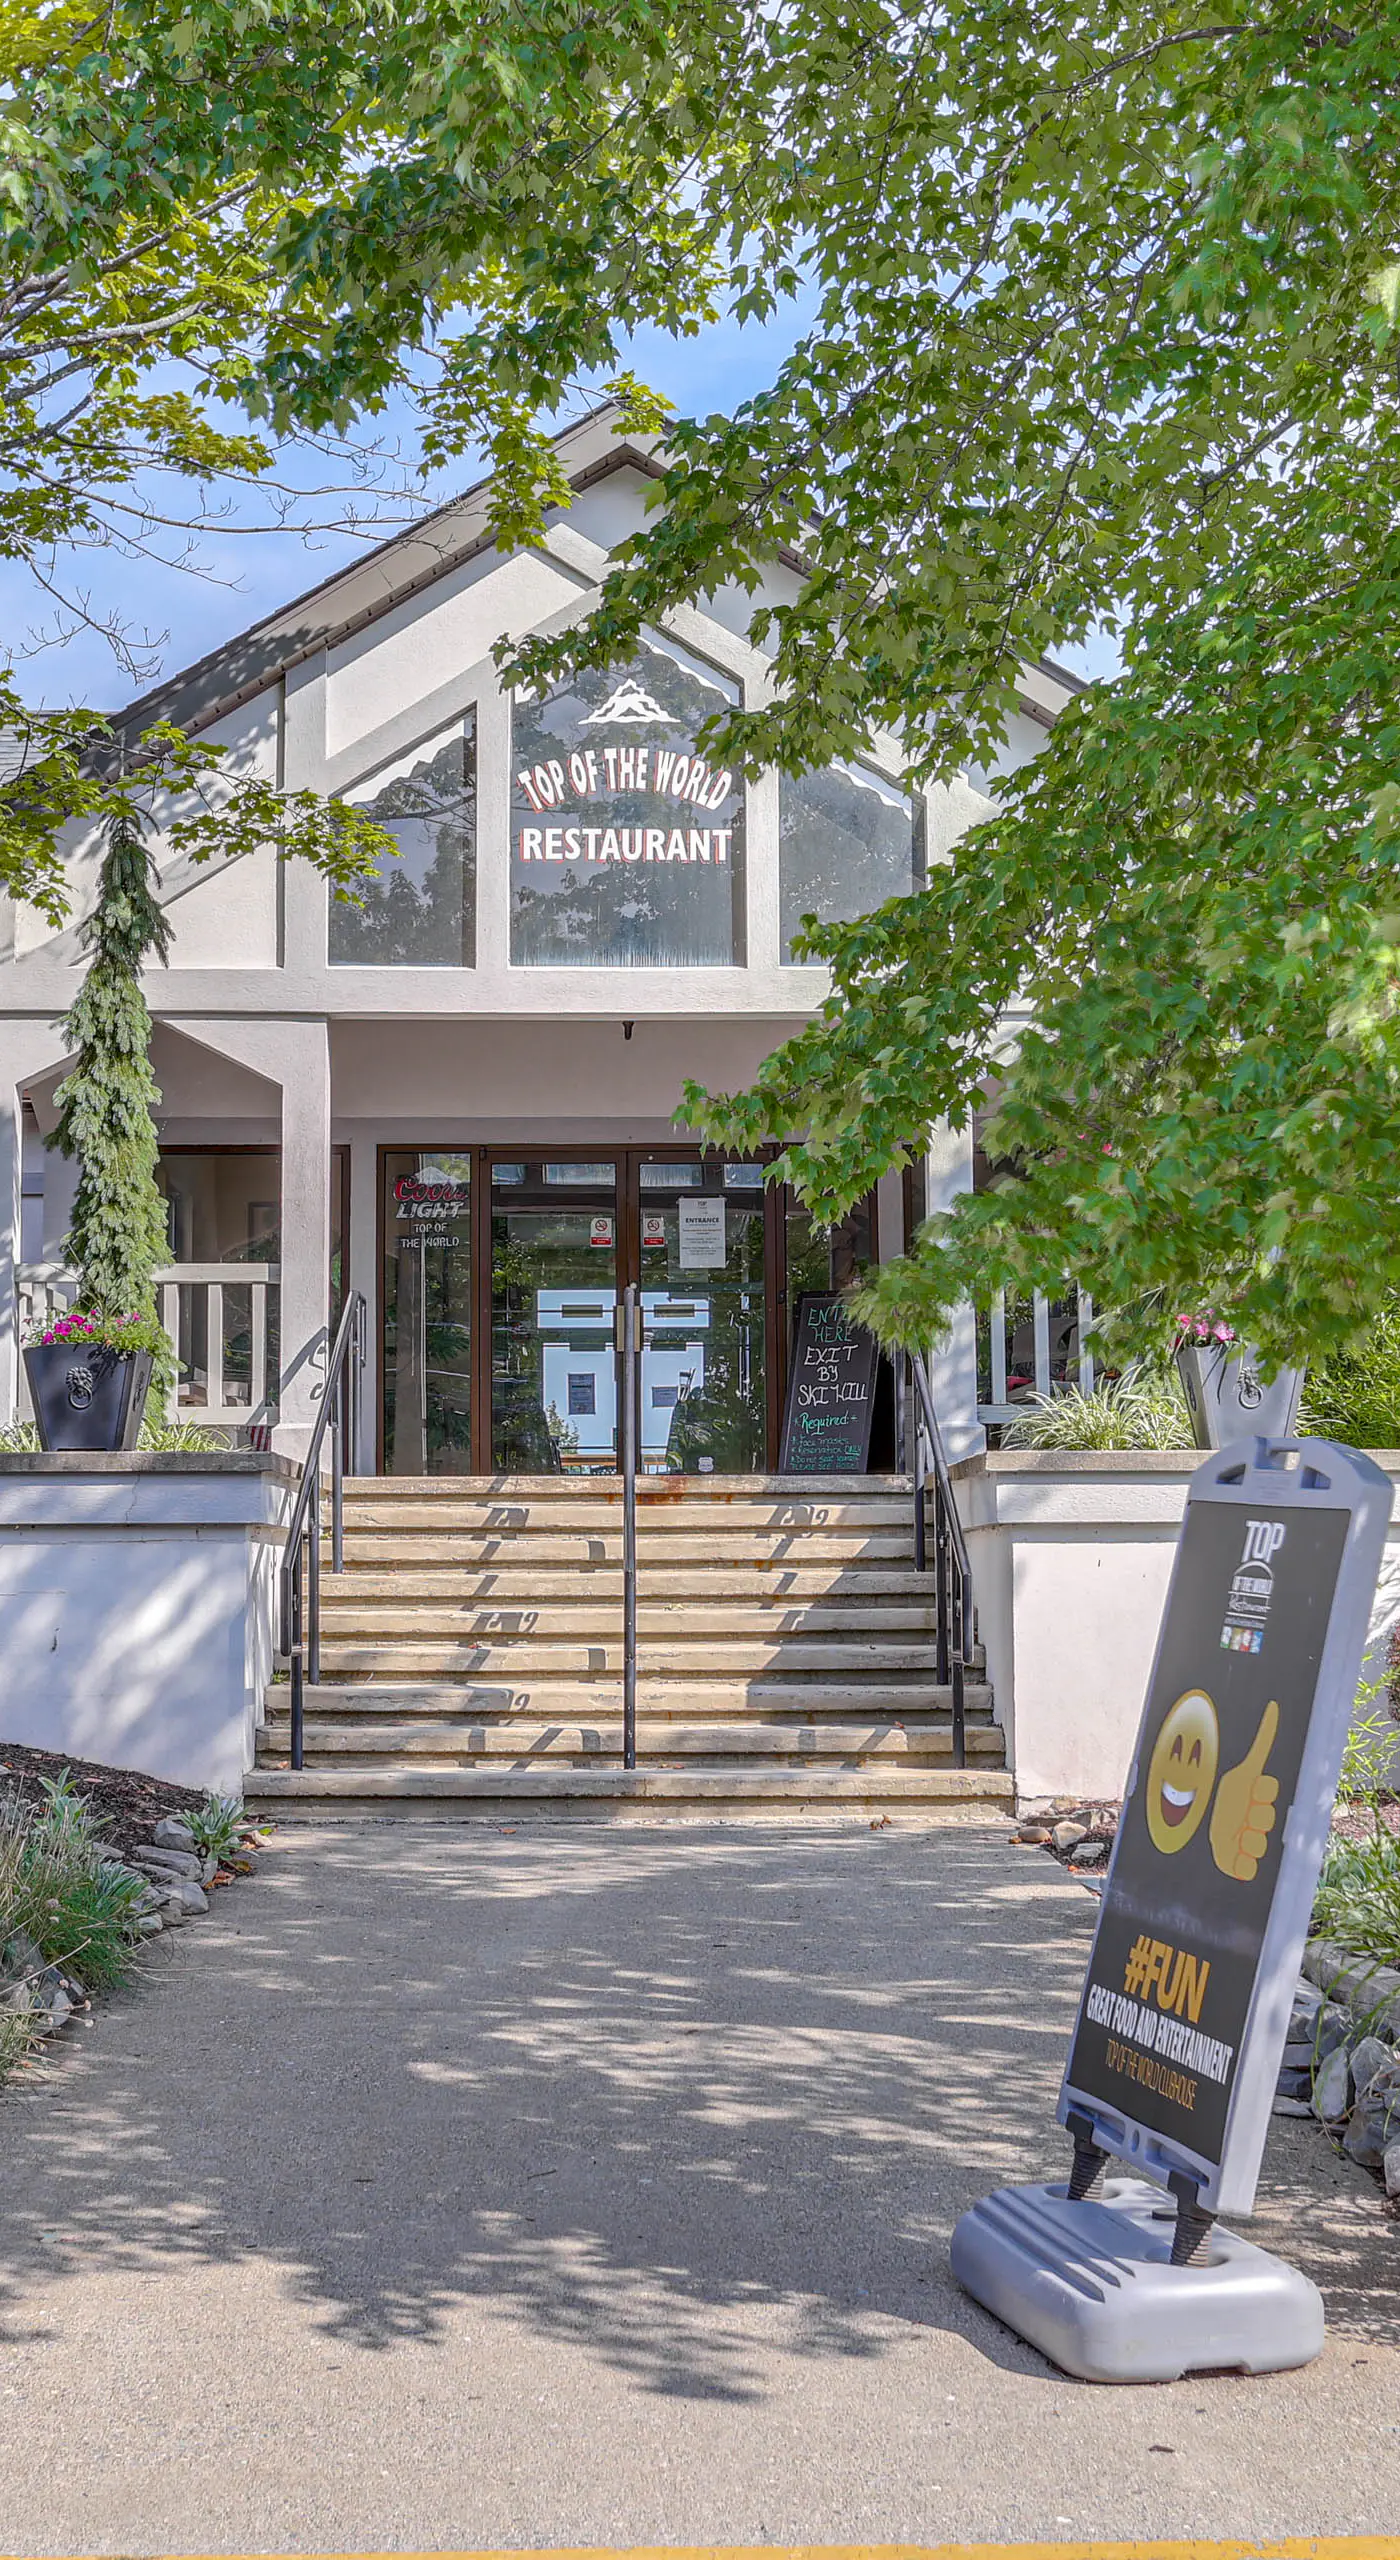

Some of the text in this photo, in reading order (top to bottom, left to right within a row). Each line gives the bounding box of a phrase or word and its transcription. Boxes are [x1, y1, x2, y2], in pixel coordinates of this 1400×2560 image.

[516, 748, 733, 813] TOP OF THE WORLD
[519, 827, 733, 865] RESTAURANT
[393, 1175, 469, 1201] Coors
[396, 1201, 464, 1219] LIGHT
[413, 1222, 448, 1233] TOP OF
[400, 1236, 460, 1248] THE WORLD
[808, 1304, 852, 1327] ENTE
[811, 1325, 853, 1342] HERE
[804, 1344, 859, 1366] EXIT
[816, 1365, 839, 1382] BY
[797, 1382, 868, 1407] SKI HILL
[1241, 1519, 1286, 1564] TOP
[1123, 1934, 1211, 2025] #FUN
[1086, 1983, 1234, 2086] GREAT FOOD AND ENTERTAINMENT
